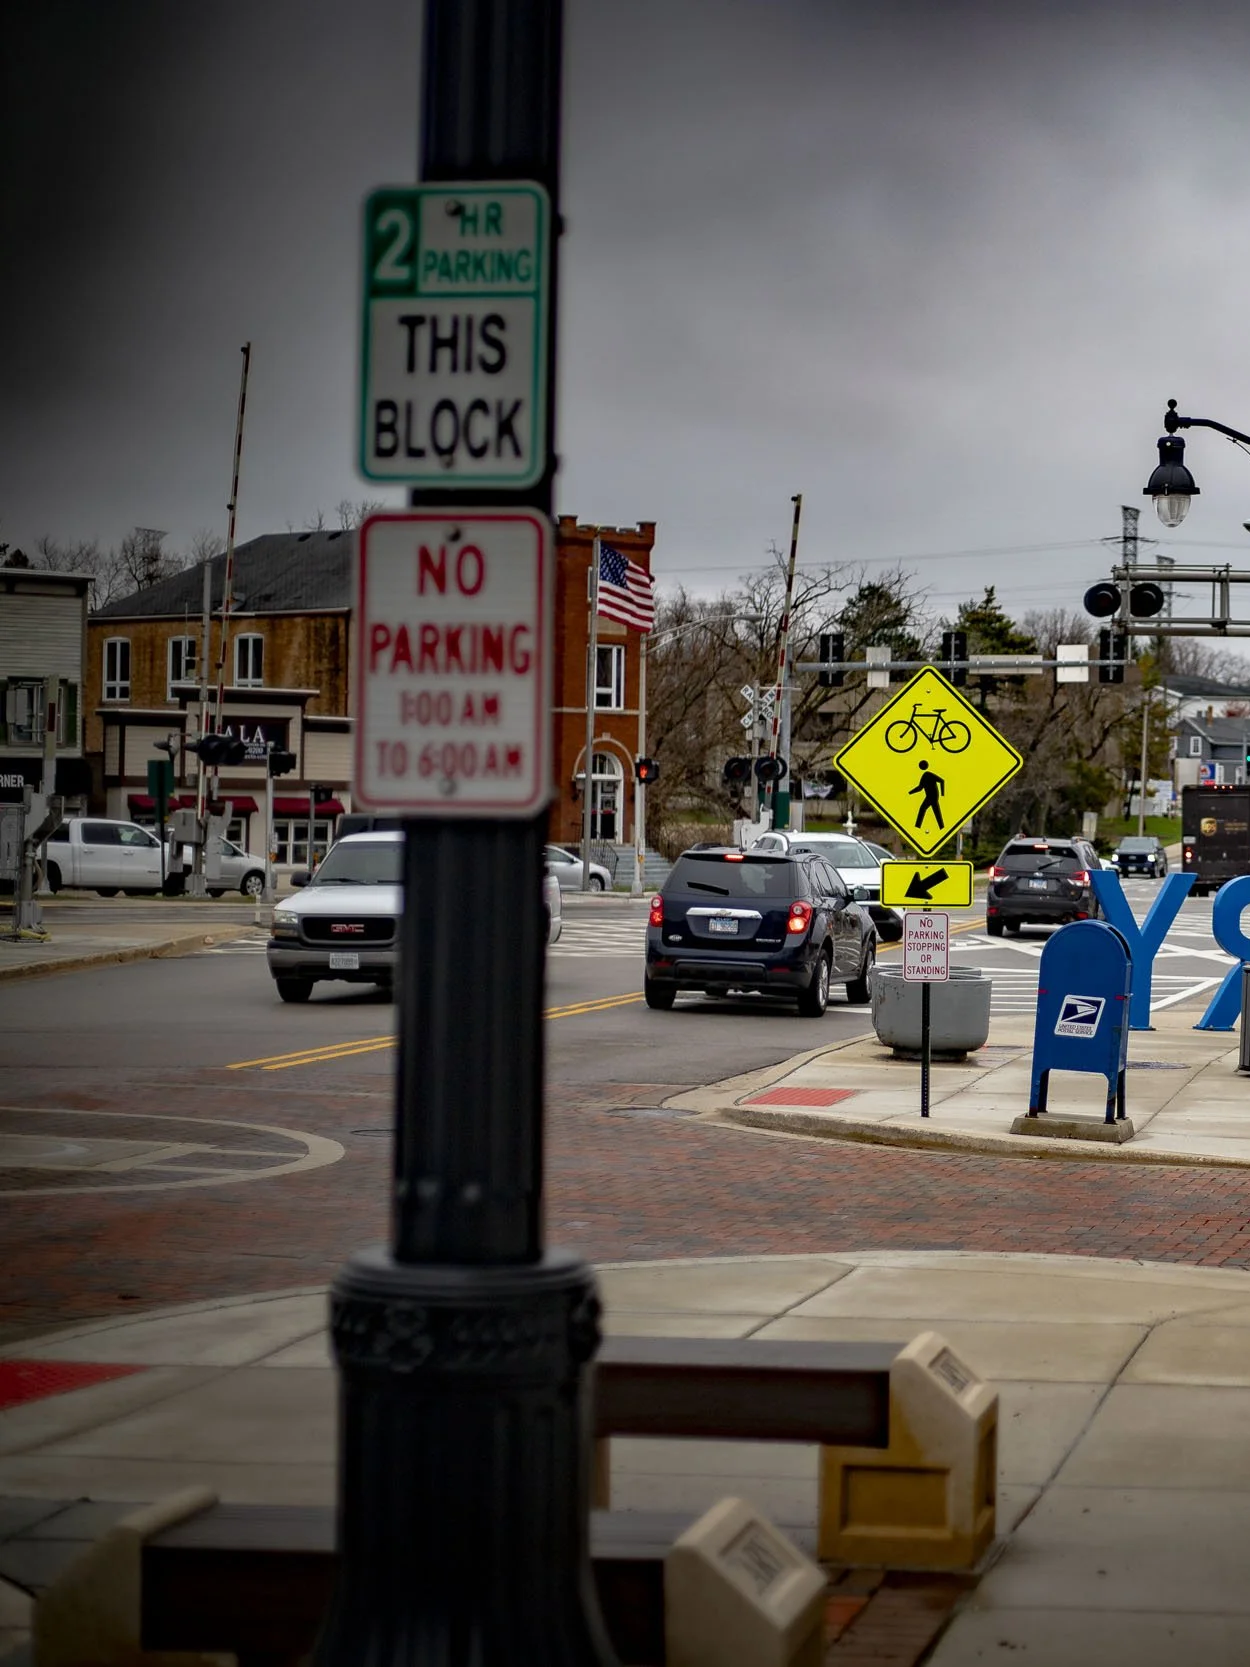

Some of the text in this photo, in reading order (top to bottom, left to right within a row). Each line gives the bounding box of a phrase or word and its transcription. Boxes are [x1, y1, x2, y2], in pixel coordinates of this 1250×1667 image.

[374, 202, 502, 280] 2 HR
[423, 249, 532, 282] PARKING
[398, 313, 507, 374] THIS
[374, 398, 523, 458] BLOCK
[417, 544, 485, 596] NO
[369, 623, 531, 675] PARKING
[401, 690, 501, 727] 1:00 AM
[376, 740, 523, 778] TO 6:00 AM
[331, 924, 365, 933] GMC
[908, 931, 944, 940] PARKING
[920, 919, 933, 928] NO
[907, 943, 946, 951] STOPPING
[920, 954, 932, 963] OR
[907, 966, 946, 975] STANDING
